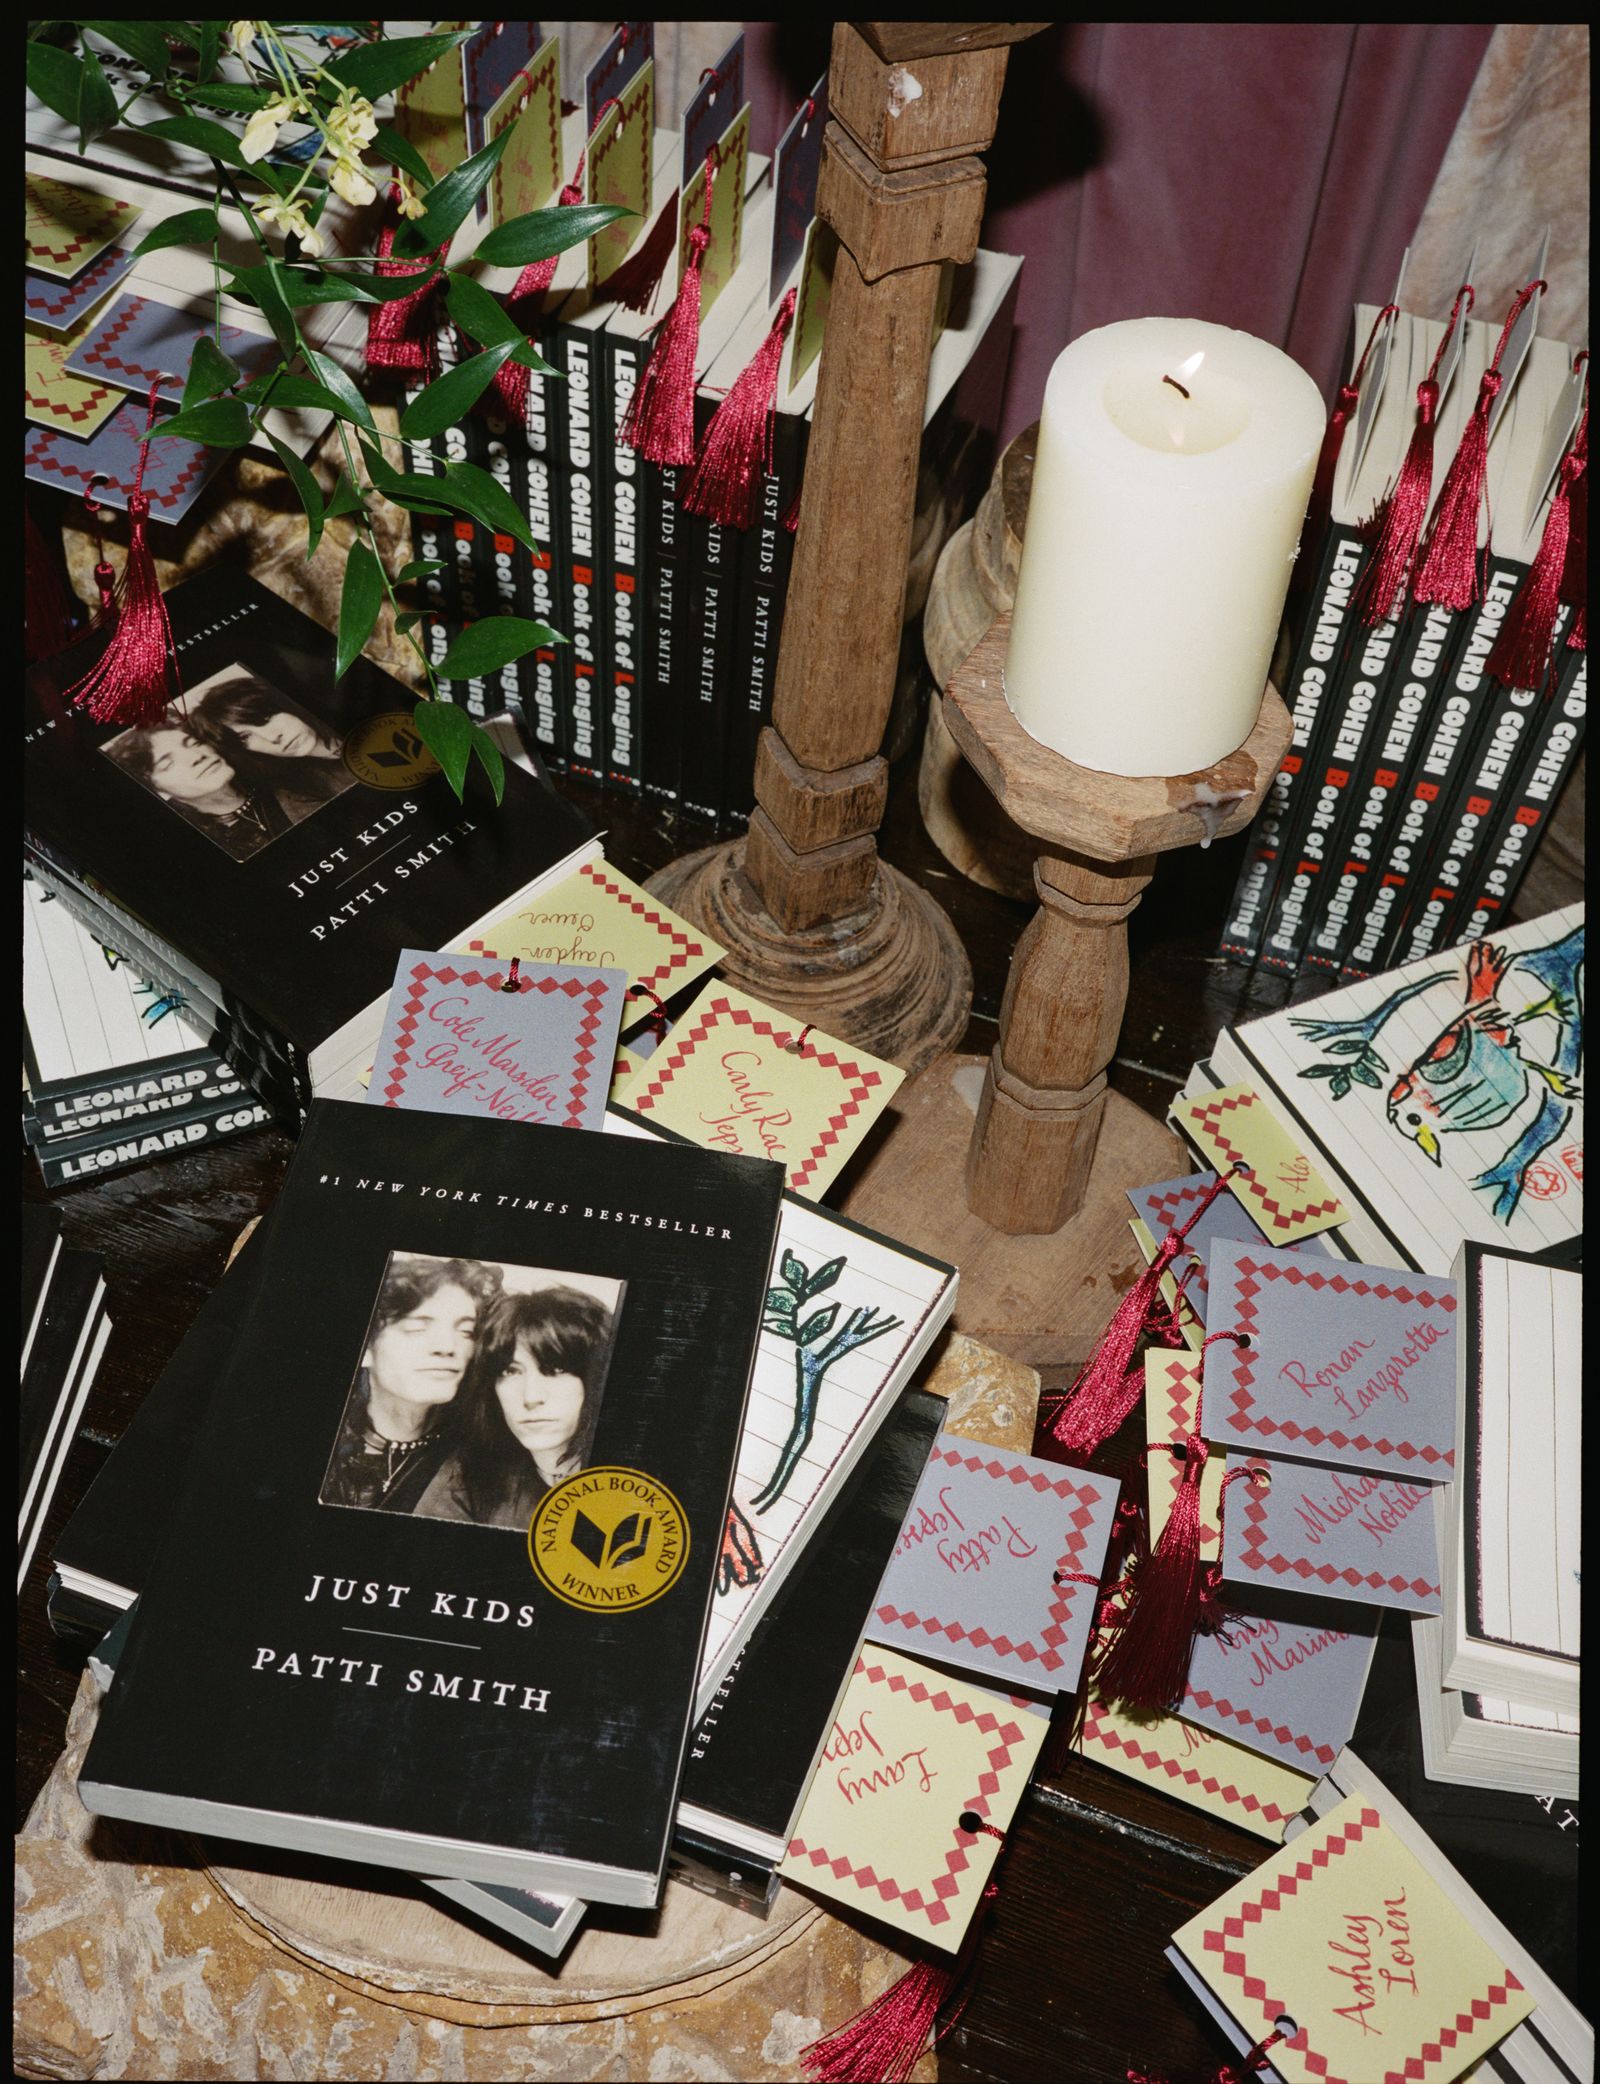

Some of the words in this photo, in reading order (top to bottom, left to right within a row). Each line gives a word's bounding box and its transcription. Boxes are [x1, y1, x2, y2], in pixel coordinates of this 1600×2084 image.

[567, 340, 592, 468] LEONARD
[527, 458, 551, 543] COHEN
[662, 469, 676, 492] ST
[763, 472, 780, 521] JUST
[570, 473, 592, 557] COHEN
[615, 481, 636, 566] COHEN
[660, 501, 676, 546] KIDS
[494, 534, 517, 599] Book
[531, 552, 552, 614] Book
[759, 527, 776, 575] KIDS
[572, 565, 594, 634] Book
[615, 572, 635, 642] Book
[658, 567, 673, 622] PATTI
[703, 586, 719, 641] PATTI
[754, 596, 771, 650] PATTI
[1309, 540, 1363, 662] LEONARD
[574, 635, 594, 661] of
[616, 643, 635, 669] of
[657, 628, 673, 686] SMITH
[1455, 571, 1519, 693] LEONARD
[534, 649, 556, 745] Longing
[700, 646, 716, 704] SMITH
[748, 656, 765, 713] SMITH
[572, 664, 595, 759] Longing
[611, 671, 635, 766] Longing
[1292, 666, 1326, 749] COHEN
[1332, 681, 1376, 762] COHEN
[1382, 683, 1427, 762] COHEN
[1423, 696, 1471, 776] COHEN
[1475, 711, 1525, 791] COHEN
[1525, 722, 1577, 801] COHEN
[1275, 755, 1304, 817] Book
[1311, 767, 1350, 830] Book
[1359, 768, 1399, 831] Book
[1399, 781, 1440, 844] Book
[288, 847, 351, 898] JUST
[357, 800, 420, 847] KIDS
[1262, 819, 1280, 847] of
[1303, 831, 1325, 861] of
[1350, 833, 1372, 861] of
[1449, 796, 1493, 858] Book
[1495, 806, 1541, 868] Book
[310, 873, 391, 941] PATTI
[393, 820, 478, 882] SMITH
[1389, 845, 1411, 874] of
[1439, 860, 1461, 888] of
[1484, 869, 1506, 897] of
[1229, 848, 1278, 939] Longing
[1271, 861, 1321, 951] Longing
[1316, 861, 1369, 951] Longing
[1352, 873, 1406, 963] Longing
[1401, 886, 1455, 966] Longin
[429, 997, 485, 1043] Cole
[471, 1032, 560, 1113] Marsden
[721, 1051, 774, 1115] Carly
[44, 1091, 194, 1138] LEONARD
[54, 1069, 208, 1118] LEONARD
[61, 1123, 209, 1179] LEONARD
[215, 1105, 273, 1133] COH
[319, 1174, 342, 1187] #1
[356, 1178, 405, 1194] NEW
[419, 1185, 482, 1204] YORK
[497, 1195, 570, 1215] TIMES
[584, 1207, 733, 1240] BESTSELLER
[1278, 1336, 1376, 1398] Ronan
[541, 1477, 605, 1553] NATIONAL
[608, 1476, 658, 1512] BOOK
[654, 1508, 680, 1577] AWARD
[937, 1514, 1038, 1574] Patty
[1357, 1484, 1433, 1548] Nobile
[305, 1574, 411, 1609] JUST
[431, 1592, 536, 1629] KIDS
[561, 1571, 642, 1602] WINNER
[251, 1647, 384, 1687] PATTI
[405, 1670, 552, 1714] SMITH
[1327, 1912, 1385, 2036] Ashley
[1378, 1885, 1421, 1999] Loren
